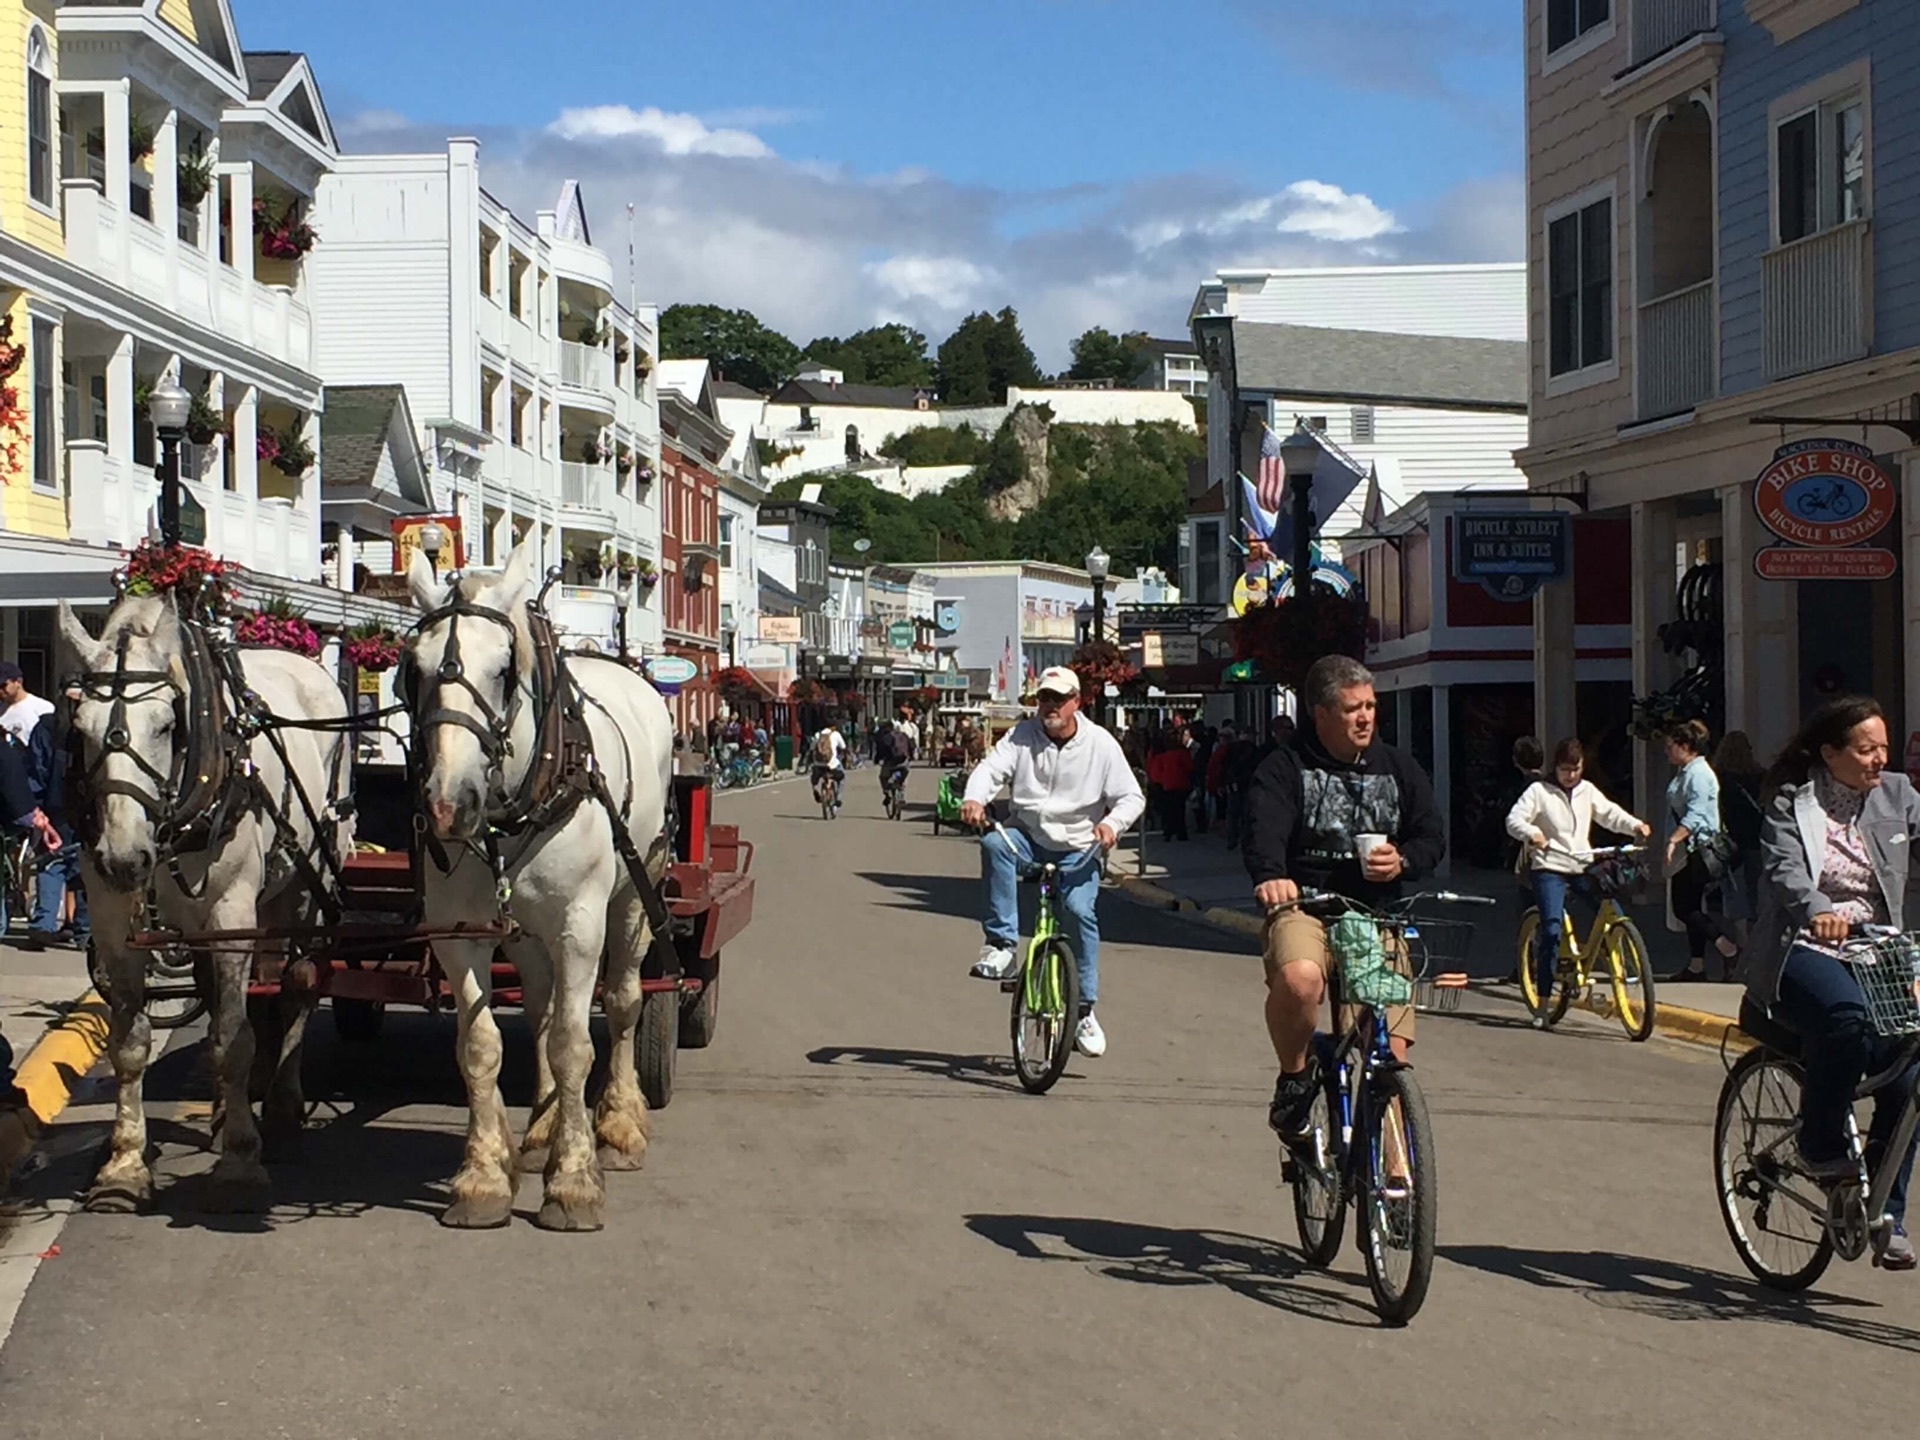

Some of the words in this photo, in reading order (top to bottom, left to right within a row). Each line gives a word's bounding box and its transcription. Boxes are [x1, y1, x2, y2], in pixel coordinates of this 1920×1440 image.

[1767, 454, 1821, 491] BIKE
[1829, 453, 1887, 491] SHOP
[1465, 520, 1509, 537] BICYCLE
[1515, 520, 1560, 537] STREET
[1768, 508, 1822, 541] BICYCLE
[1829, 507, 1884, 541] RENTALS
[1473, 542, 1494, 557] INN
[1497, 542, 1507, 557] &
[1511, 542, 1552, 557] SUITES
[1771, 553, 1787, 562] NO
[1790, 553, 1830, 562] DEPOSIT
[1833, 553, 1881, 563] REQUIRED
